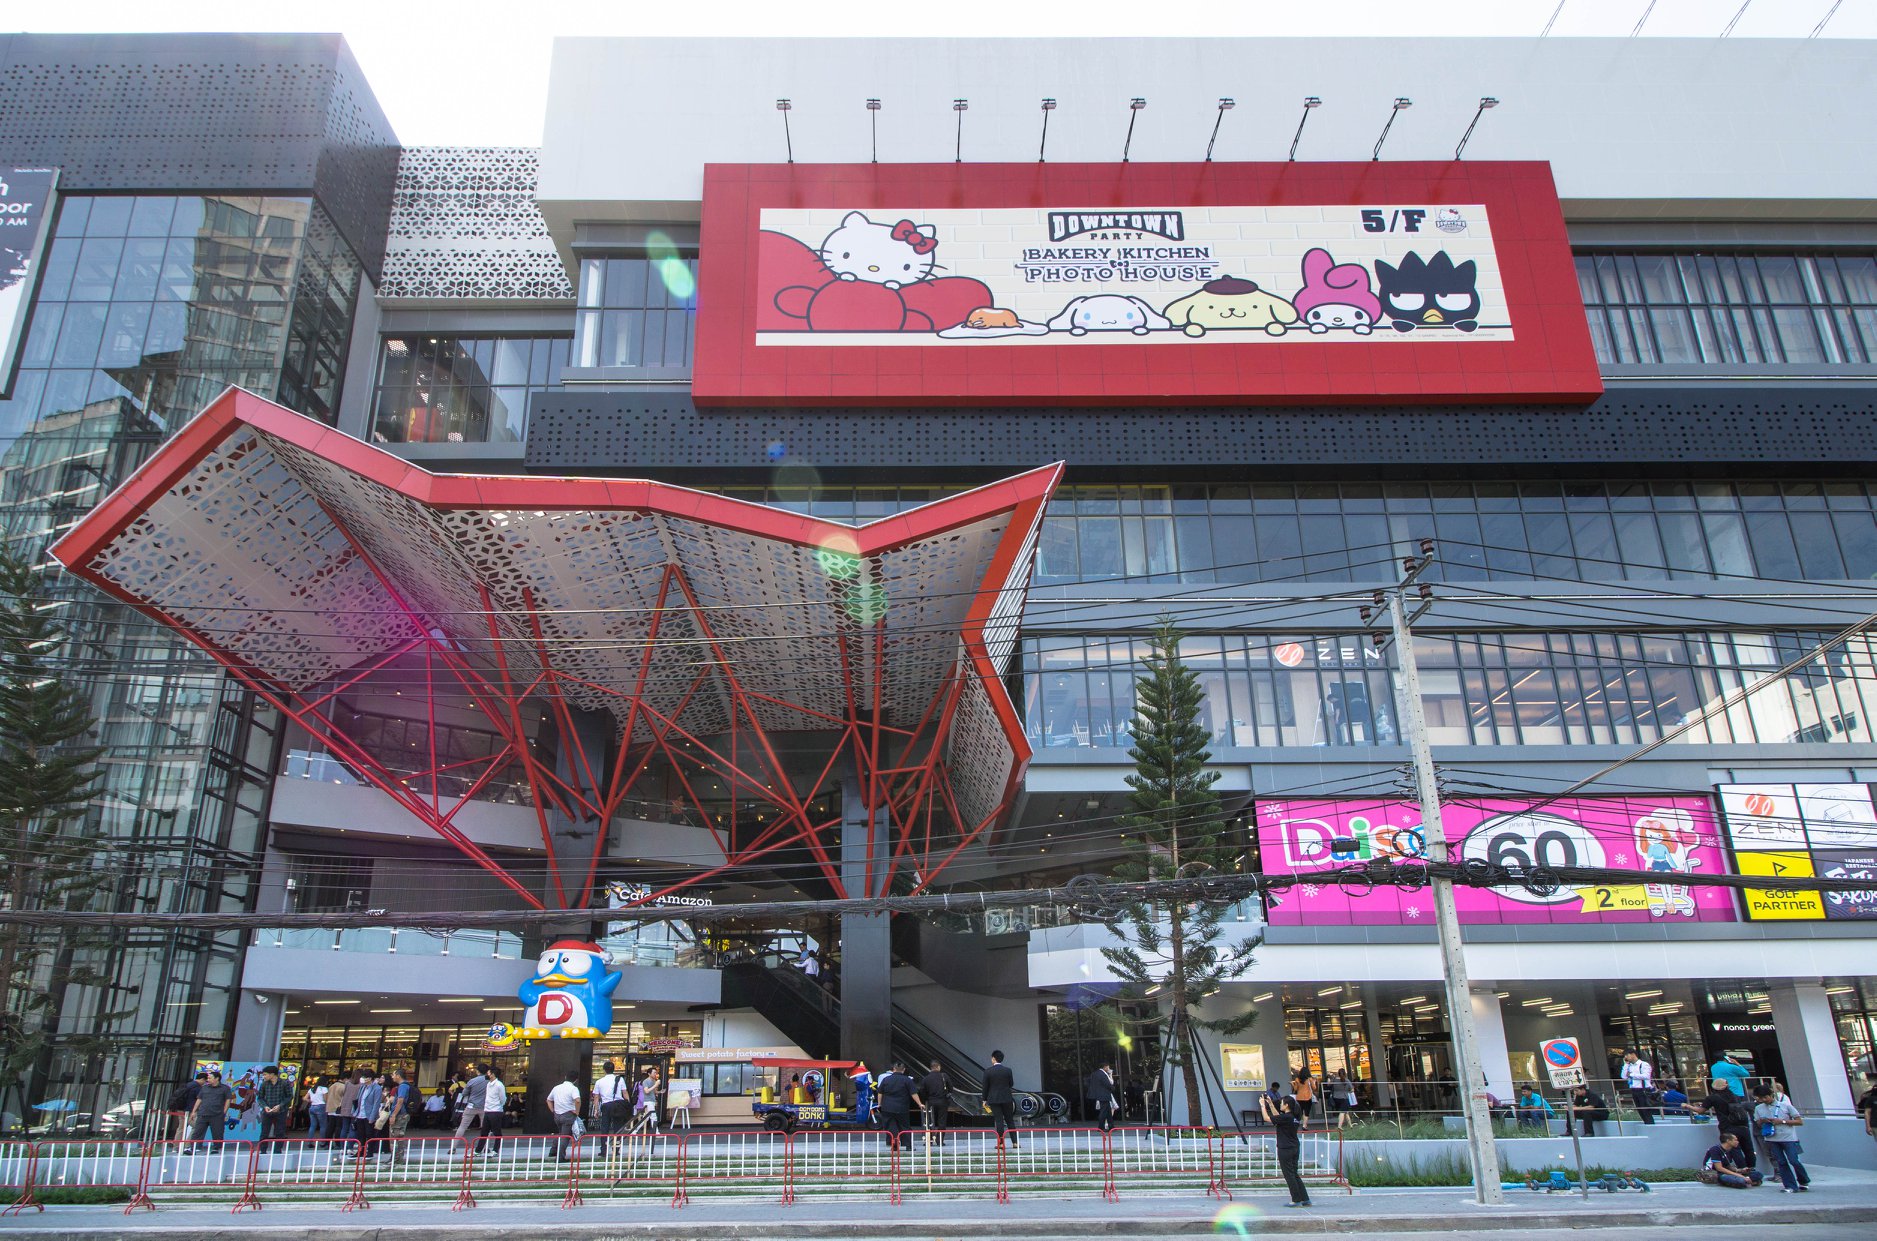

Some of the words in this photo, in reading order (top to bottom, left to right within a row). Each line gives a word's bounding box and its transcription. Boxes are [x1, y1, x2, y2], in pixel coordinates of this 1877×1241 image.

[7, 217, 28, 226] AM
[1360, 209, 1426, 233] 5/F
[1052, 214, 1179, 240] DOWNTOWN
[1090, 232, 1144, 241] PARTY
[1025, 247, 1112, 261] BAKERY
[1121, 247, 1210, 260] KITCHEN
[1027, 267, 1114, 281] PHOTO
[1122, 267, 1213, 281] HOUSE
[1317, 647, 1380, 661] ZEN
[1736, 822, 1797, 835] ZEN
[1487, 830, 1578, 870] 60
[1764, 889, 1800, 900] GOLF
[656, 895, 713, 907] Amazon
[1620, 897, 1646, 907] floor
[1753, 901, 1817, 911] PARTNER
[1752, 1024, 1776, 1032] green
[681, 1050, 705, 1059] Sweet
[706, 1050, 734, 1060] potato
[736, 1049, 766, 1059] factory
[798, 1111, 825, 1120] DONKI
